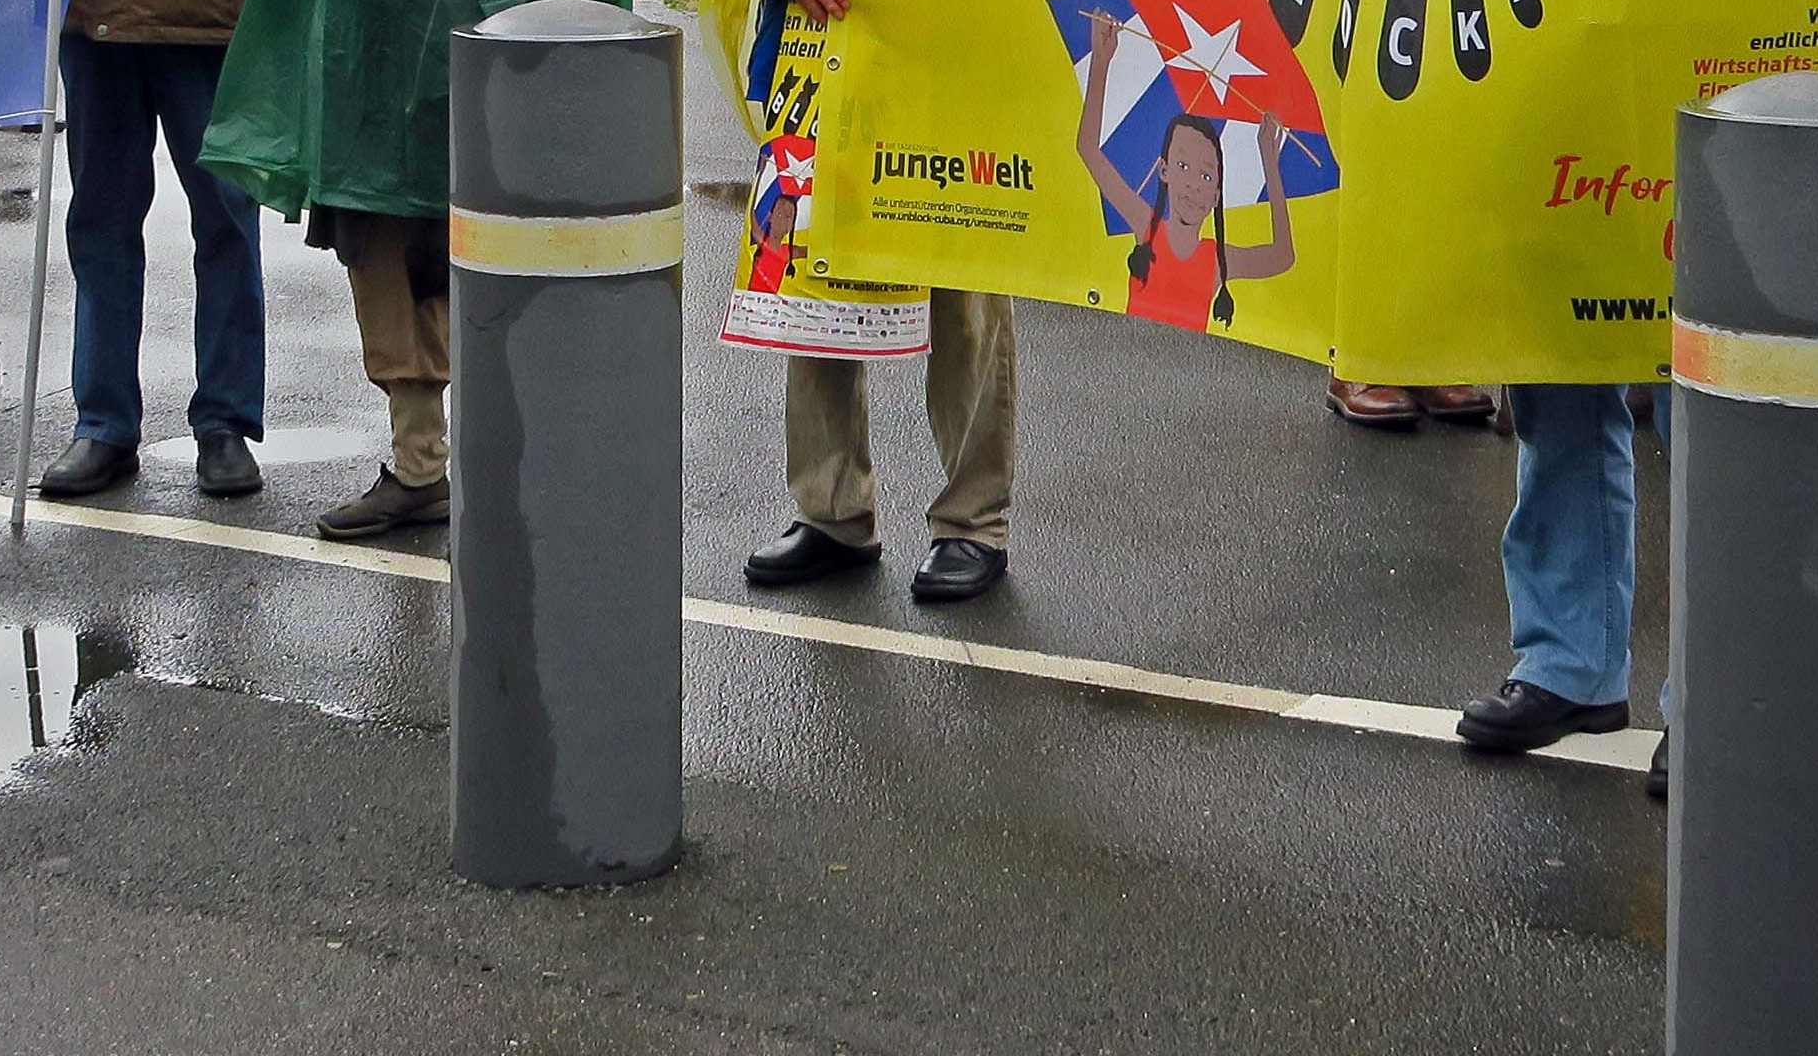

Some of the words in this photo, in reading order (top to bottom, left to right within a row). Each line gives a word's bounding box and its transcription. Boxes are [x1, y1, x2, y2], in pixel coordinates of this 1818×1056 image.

[872, 141, 965, 190] junge
[968, 150, 1034, 191] Welt
[1545, 155, 1673, 216] Infor
